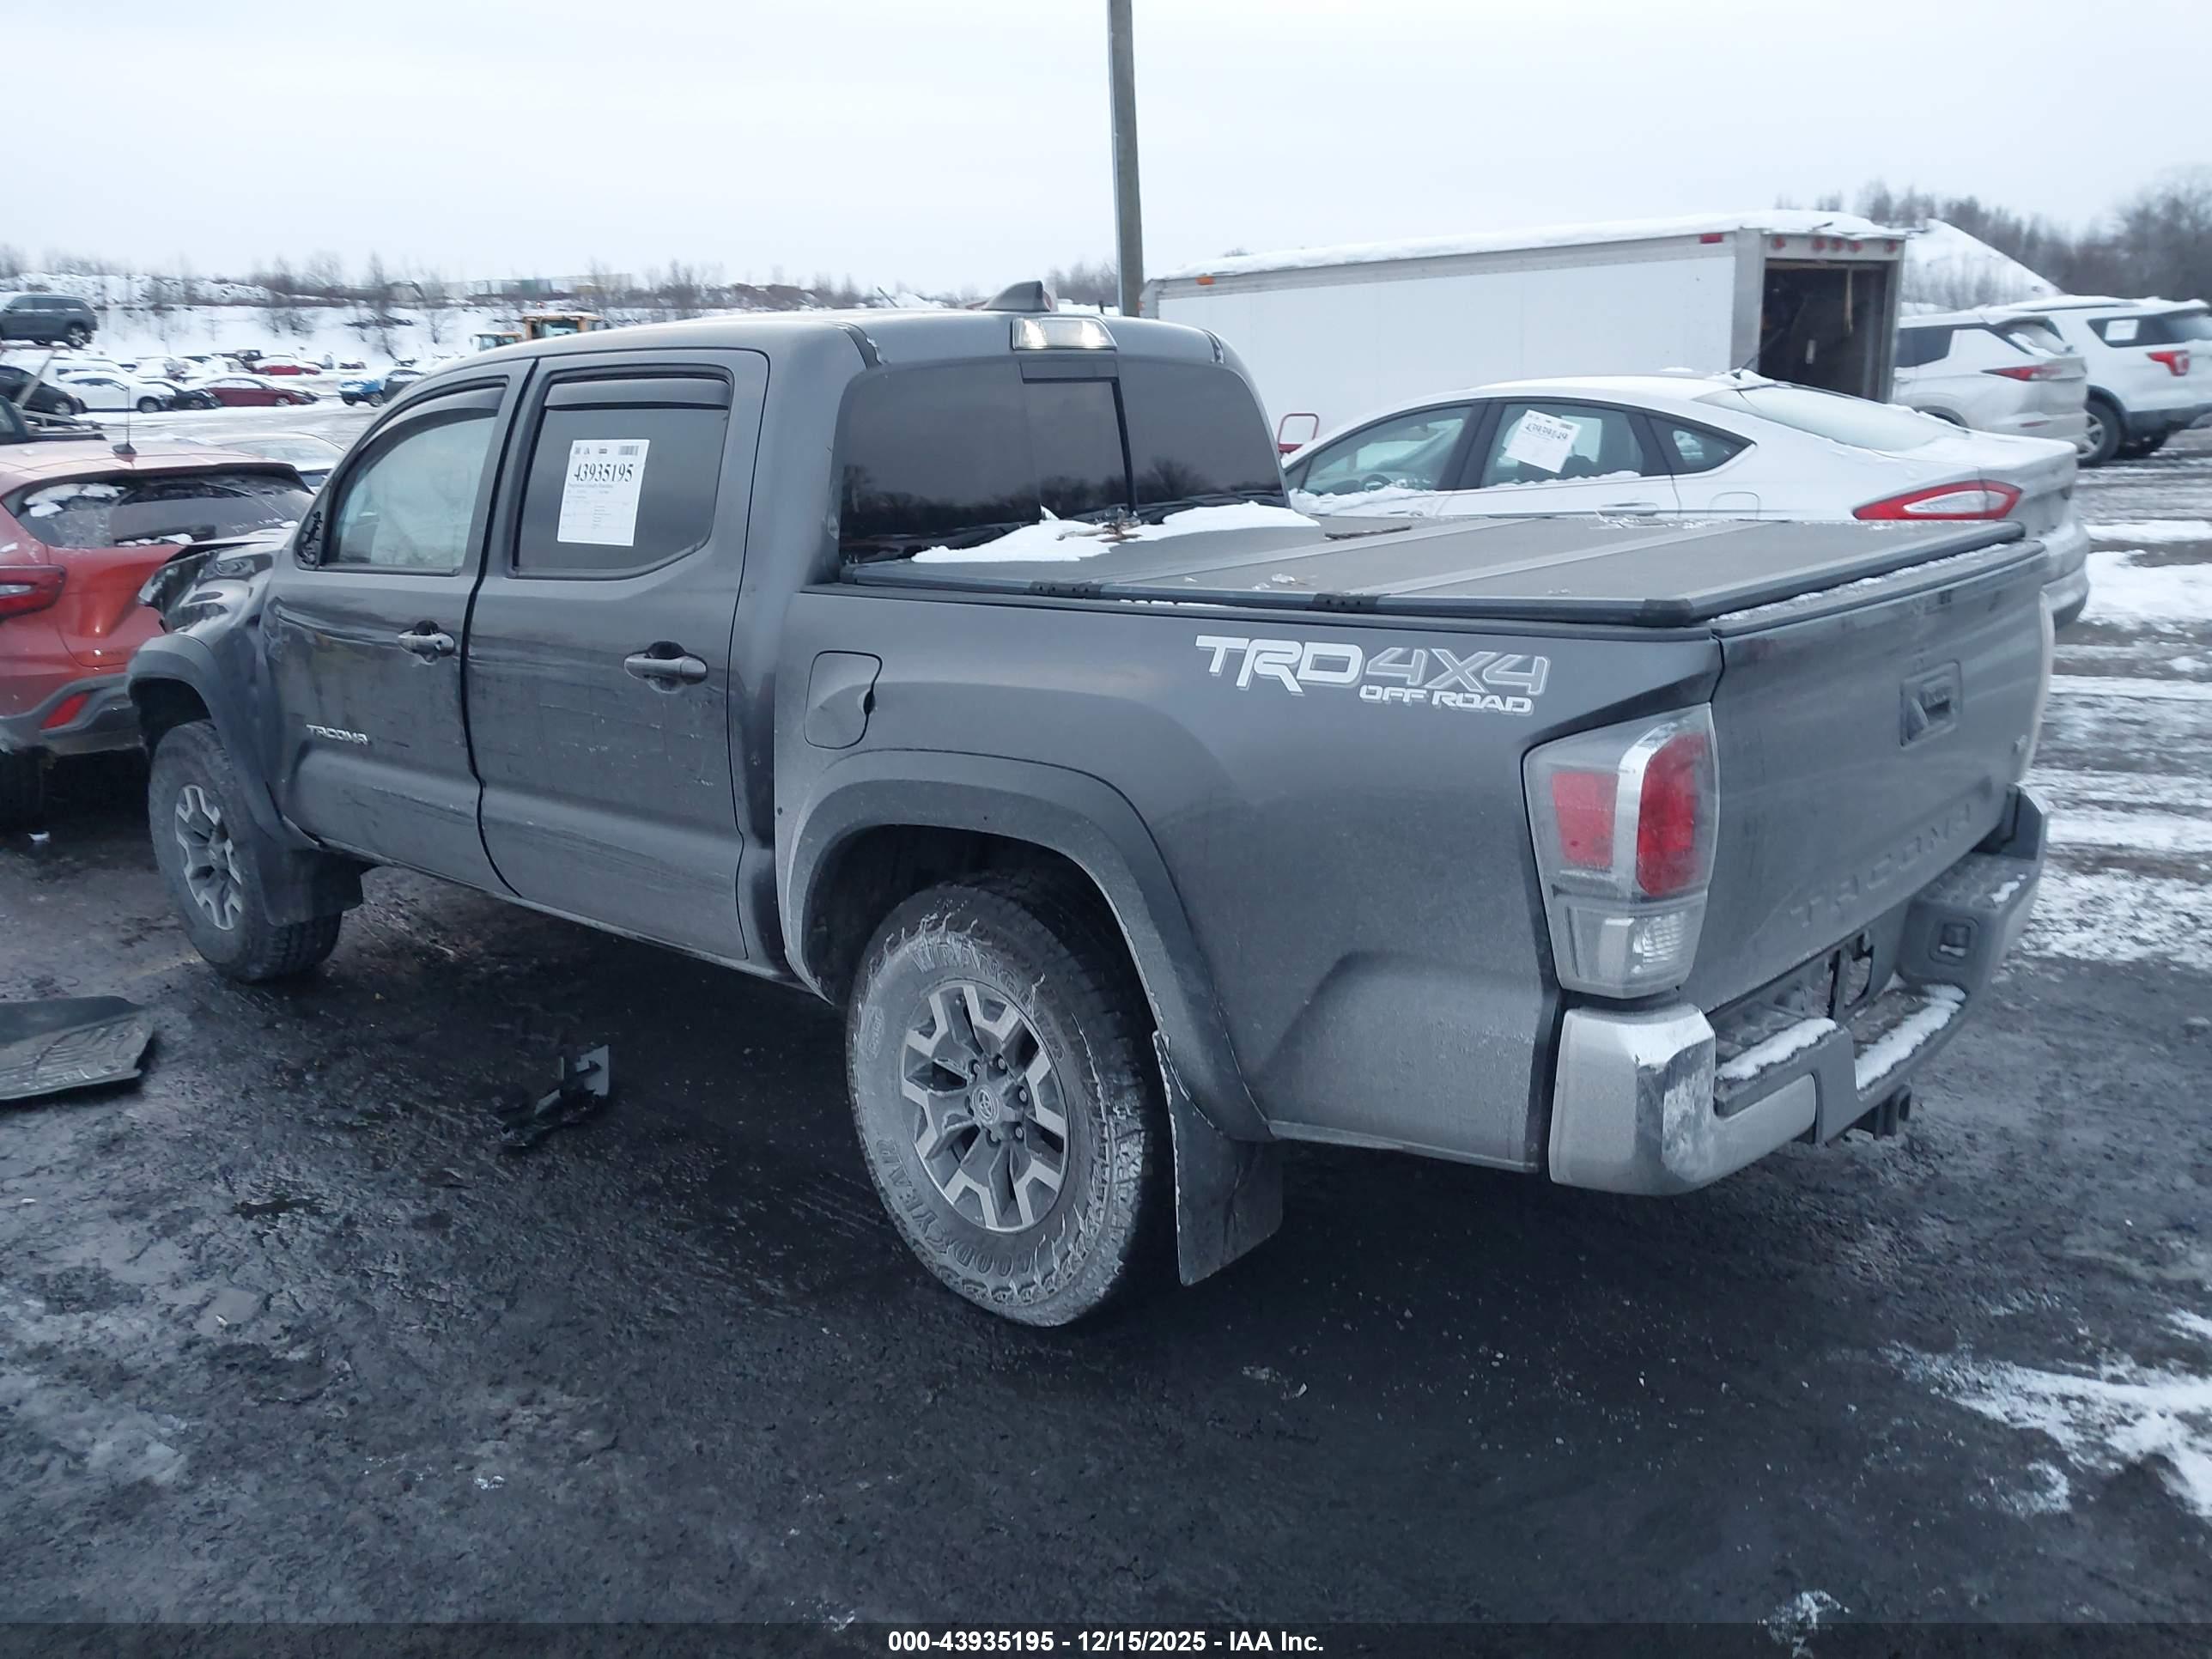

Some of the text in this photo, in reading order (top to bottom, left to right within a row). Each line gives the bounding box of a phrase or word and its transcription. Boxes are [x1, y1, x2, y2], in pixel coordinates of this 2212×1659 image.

[573, 462, 635, 483] 43935195
[1194, 634, 1365, 695] TRD
[1358, 684, 1535, 715] OFF ROAD
[306, 724, 368, 745] TACOMA
